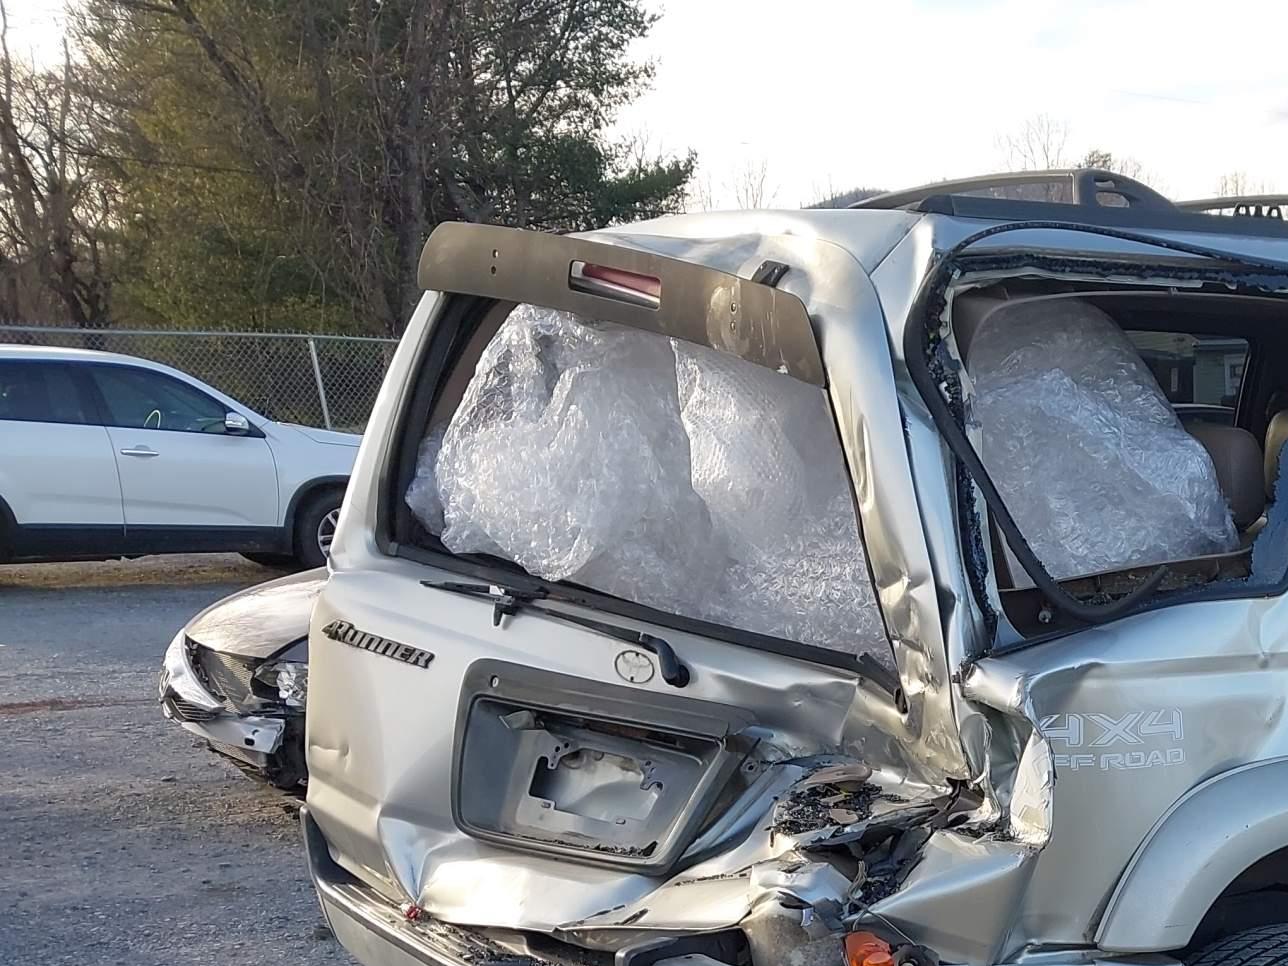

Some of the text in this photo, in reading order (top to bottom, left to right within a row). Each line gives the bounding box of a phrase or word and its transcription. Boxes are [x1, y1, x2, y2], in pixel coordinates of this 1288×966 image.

[1040, 708, 1185, 748] 4X4
[1053, 748, 1187, 771] FF ROAD
